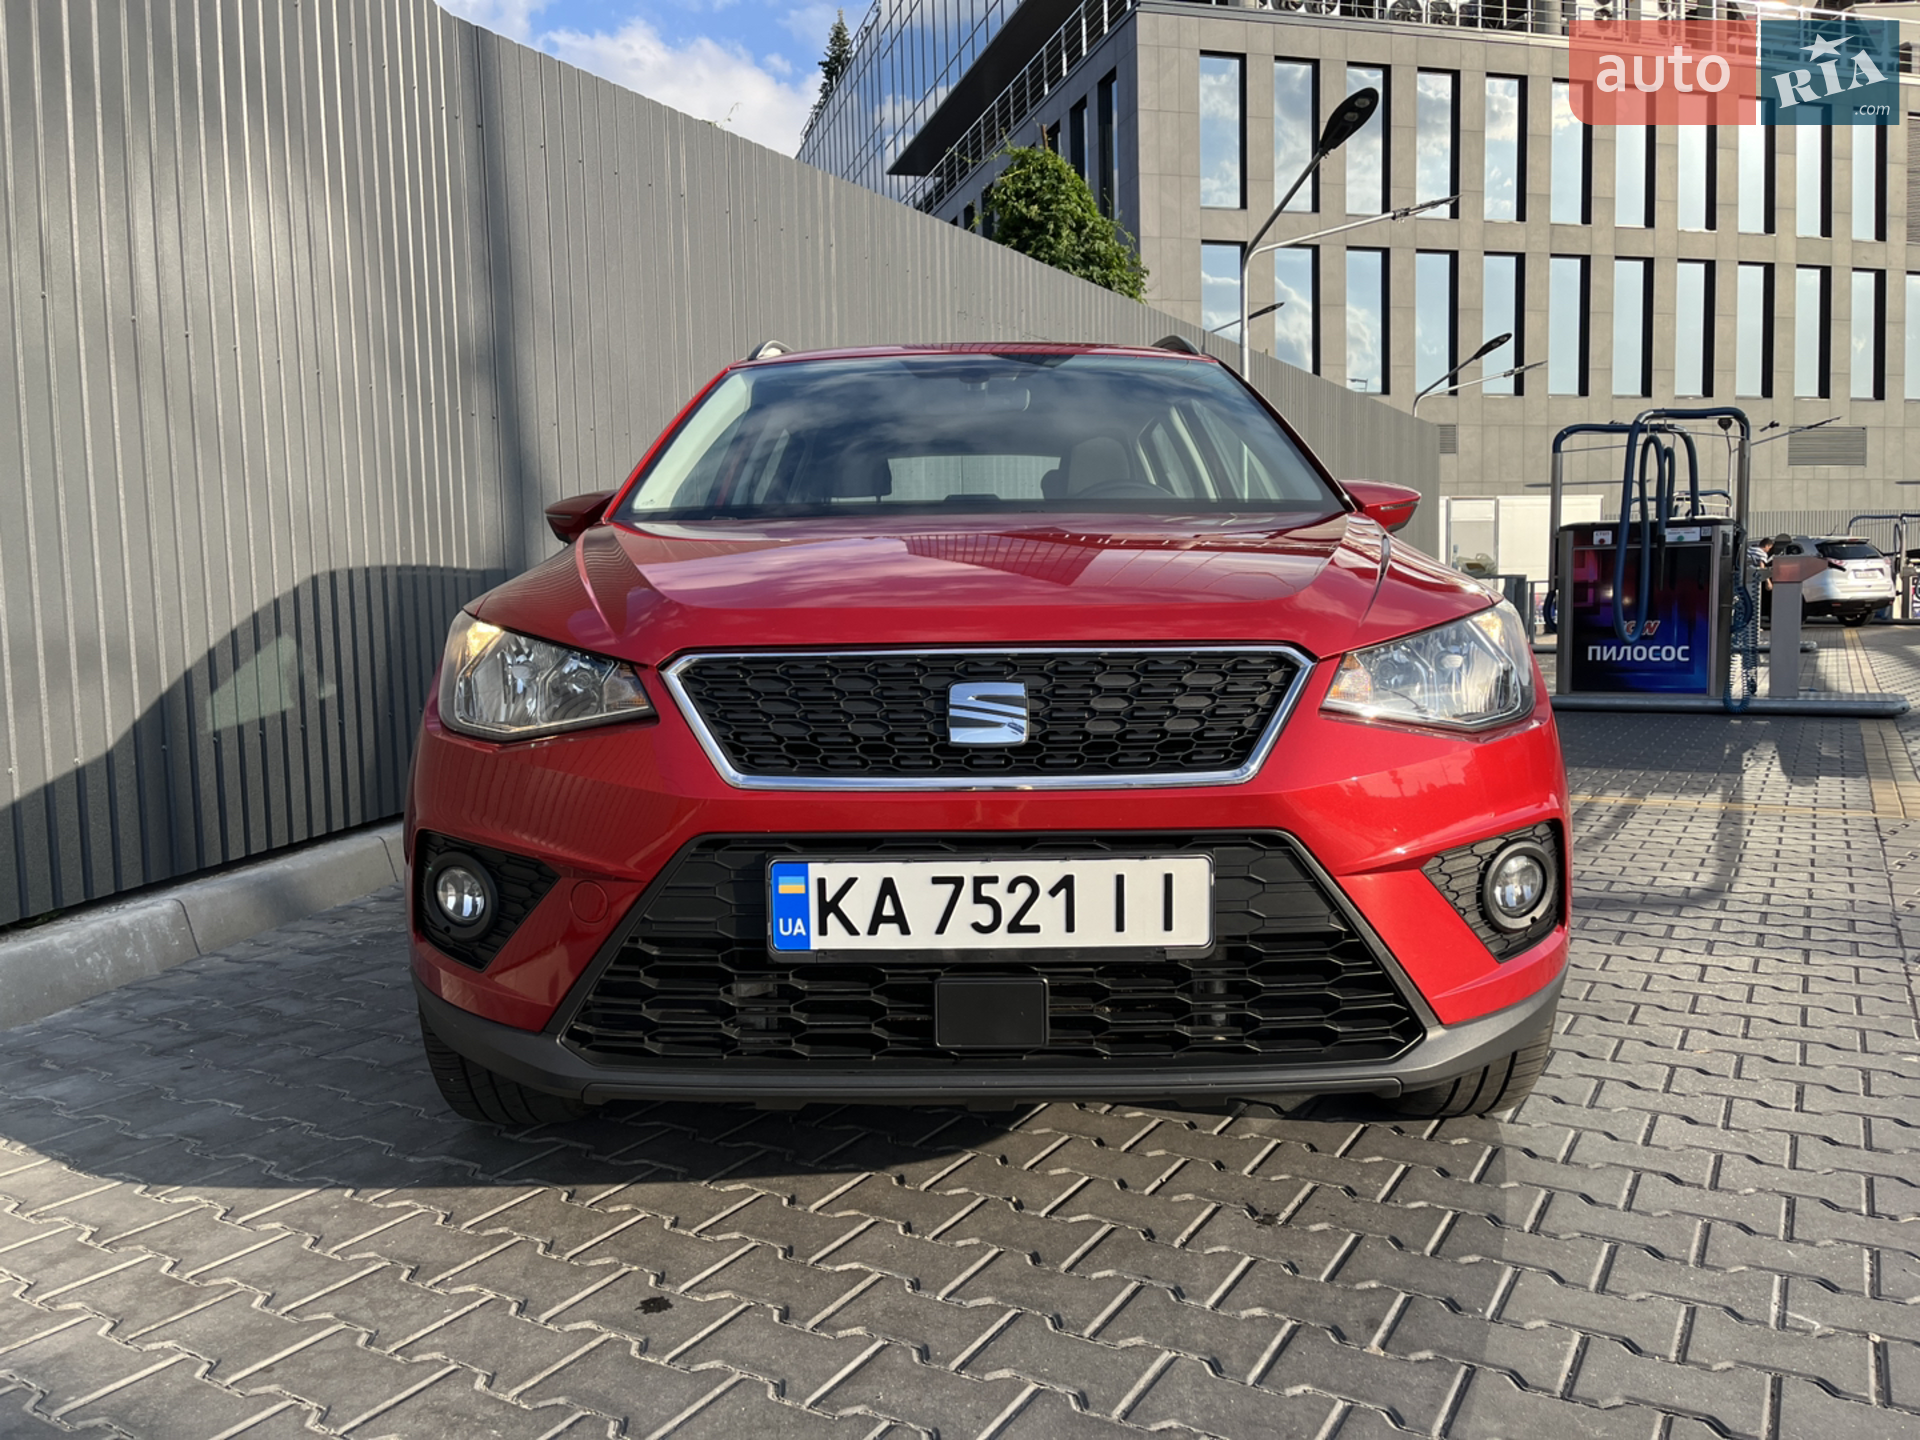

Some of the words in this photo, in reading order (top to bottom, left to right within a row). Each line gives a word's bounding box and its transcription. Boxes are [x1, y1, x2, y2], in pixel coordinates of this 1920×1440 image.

[1587, 645, 1690, 662] ПИЛОСОС
[816, 876, 912, 937] KA
[931, 873, 1076, 936] 7521
[778, 918, 807, 936] UA
